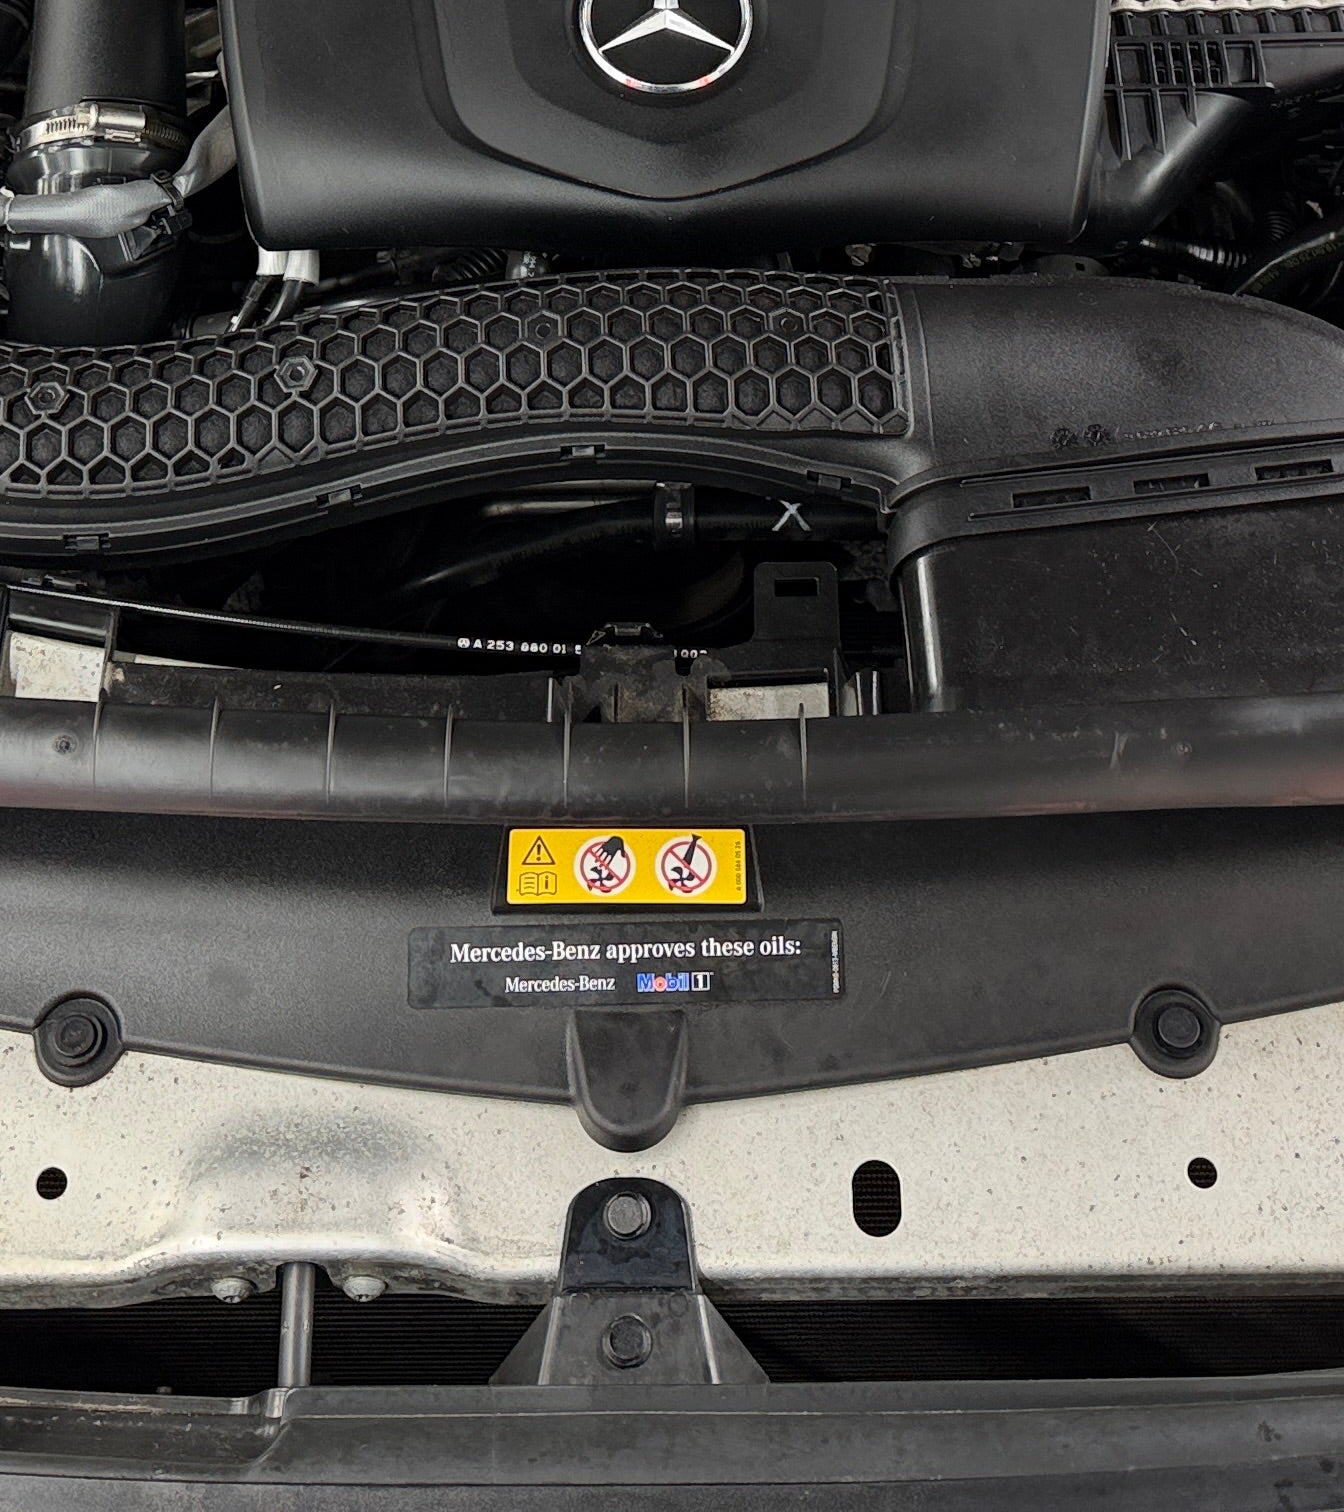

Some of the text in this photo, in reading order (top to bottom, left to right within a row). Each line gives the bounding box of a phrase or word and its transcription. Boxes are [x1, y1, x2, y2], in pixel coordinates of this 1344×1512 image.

[472, 638, 483, 649] A
[487, 640, 514, 651] 253
[449, 935, 802, 964] Mercedes-Benz approves these oils:
[504, 972, 708, 993] Mercedes-Benz Mobil 1
